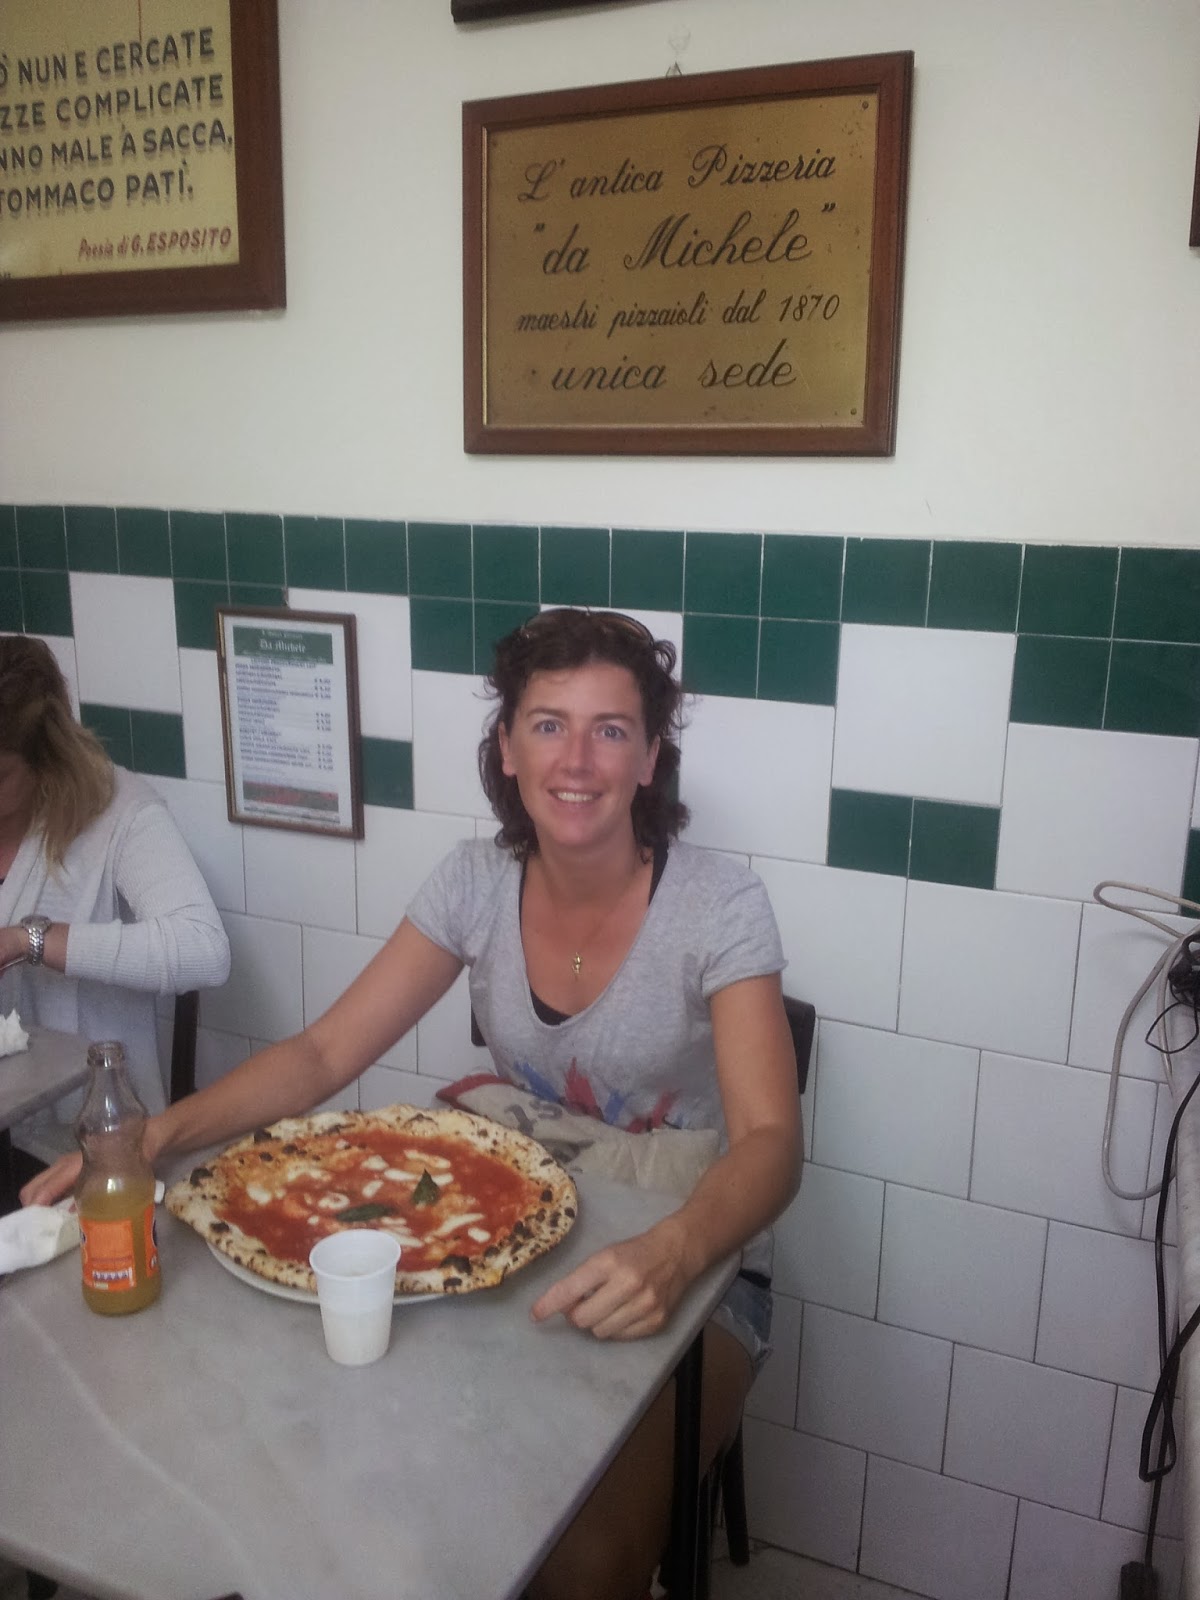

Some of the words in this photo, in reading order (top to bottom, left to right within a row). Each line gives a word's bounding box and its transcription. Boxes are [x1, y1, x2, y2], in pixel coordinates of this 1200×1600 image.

[18, 53, 67, 85] NUN
[75, 50, 88, 78] E
[96, 28, 215, 75] CERCATE
[0, 101, 46, 131] ZZE
[56, 74, 223, 123] COMPLICATE
[51, 135, 112, 166] MALE
[143, 118, 233, 154] SACCA,
[569, 158, 663, 200] antica
[687, 144, 836, 188] Pizzeria
[79, 238, 113, 259] Poesia
[517, 298, 598, 331] maestri
[608, 291, 707, 338] pizzaioli
[722, 290, 766, 323] dal
[778, 294, 840, 321] 1870
[552, 355, 667, 391] unica
[700, 338, 797, 388] sede
